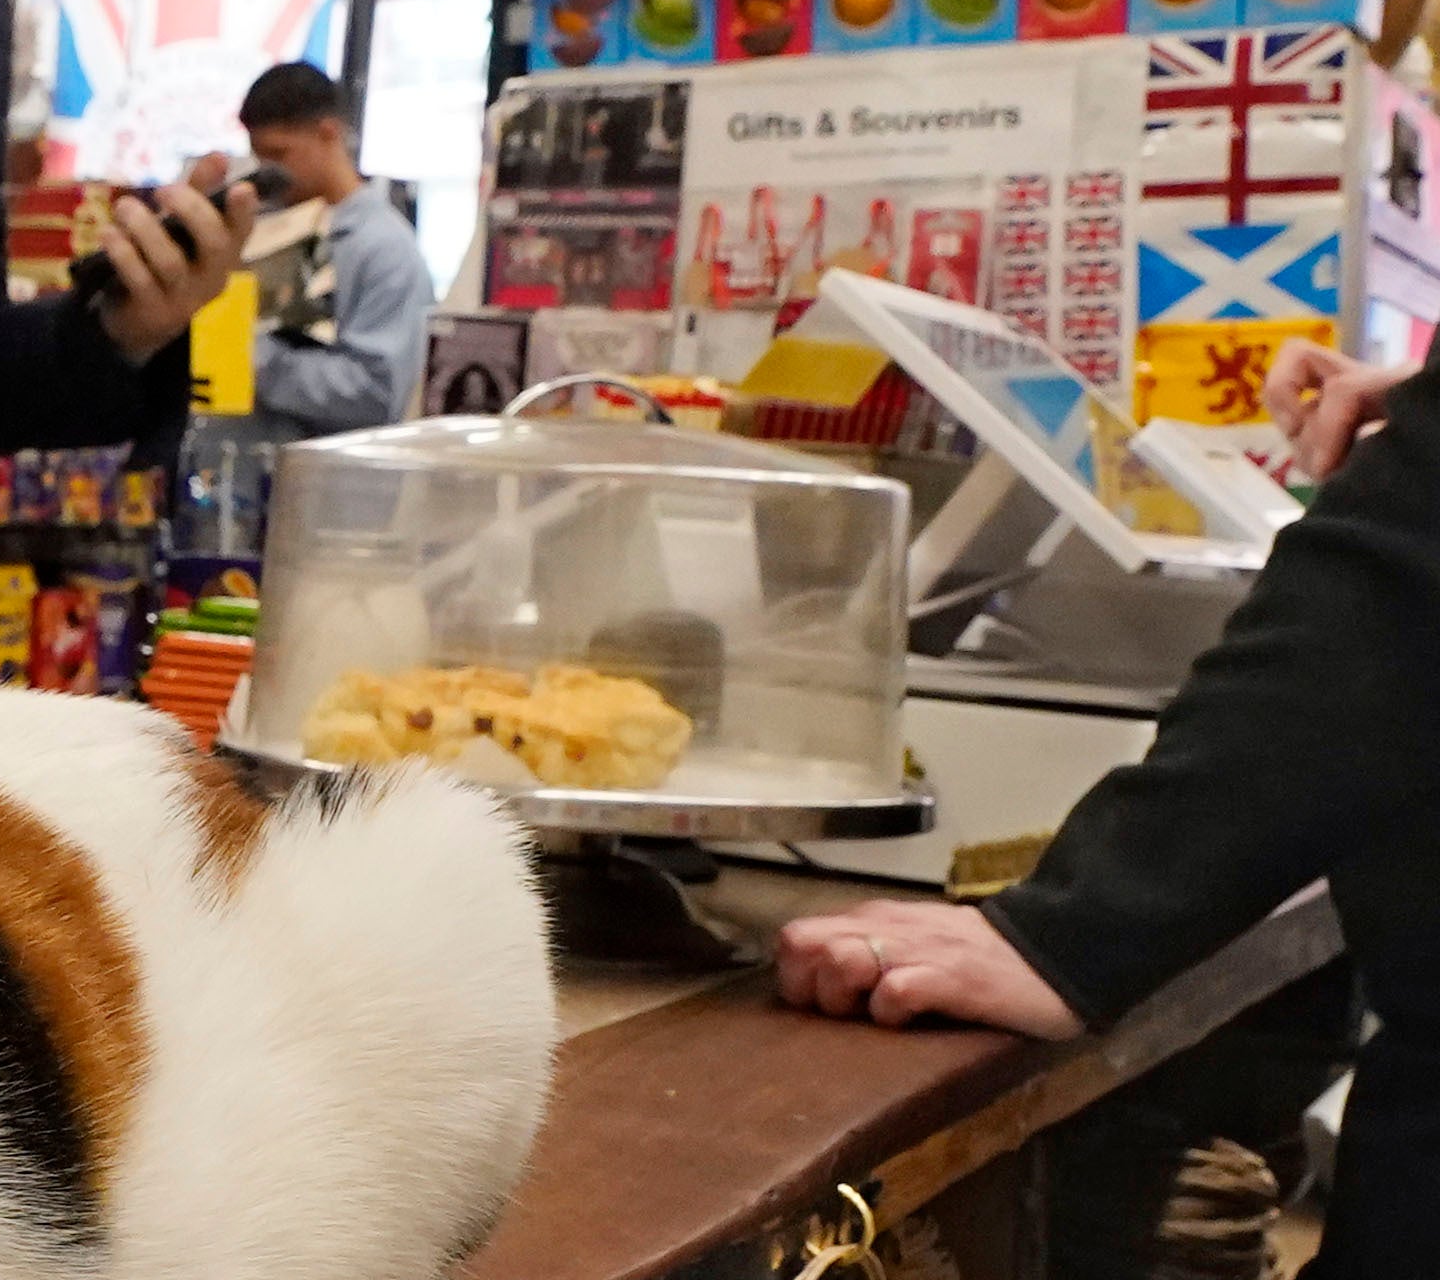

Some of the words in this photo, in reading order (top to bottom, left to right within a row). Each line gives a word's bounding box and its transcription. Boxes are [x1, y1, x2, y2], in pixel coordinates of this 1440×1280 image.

[726, 111, 803, 142] Gifts
[816, 108, 836, 138] &
[850, 104, 1020, 138] Souvenirs
